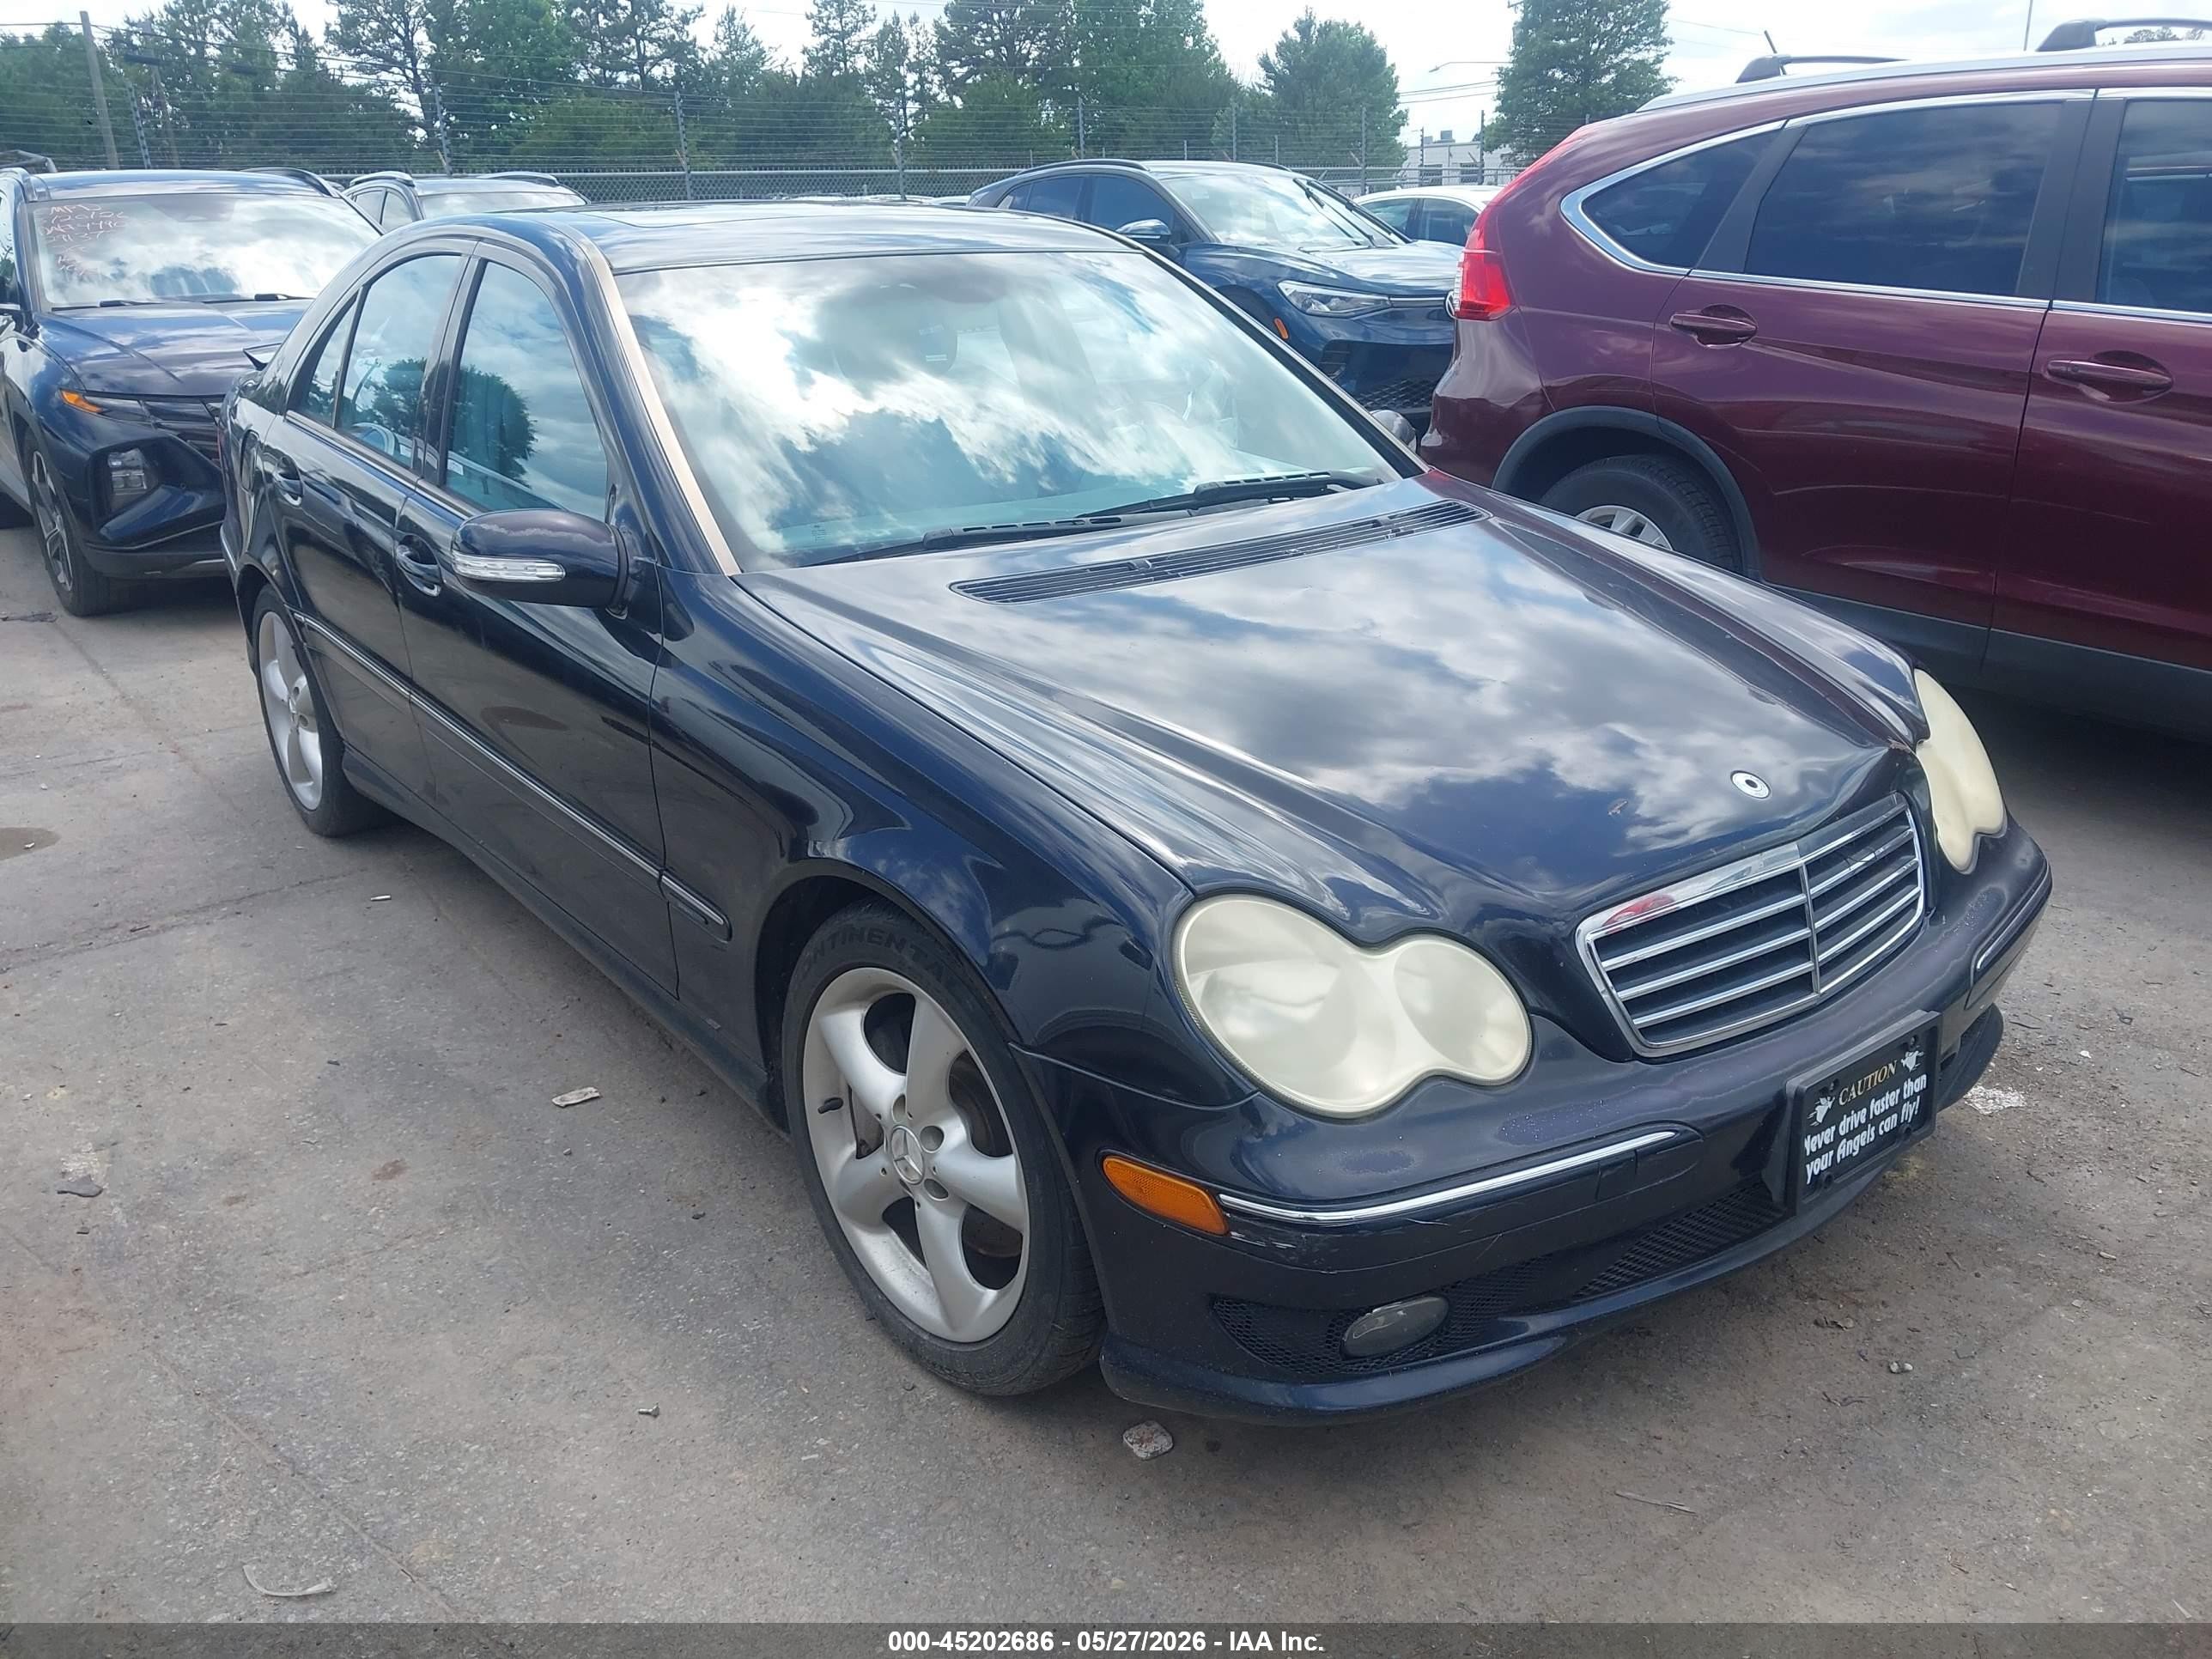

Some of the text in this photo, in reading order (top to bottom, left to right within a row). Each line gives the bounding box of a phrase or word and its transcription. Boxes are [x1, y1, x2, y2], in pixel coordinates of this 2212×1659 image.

[1838, 1060, 1898, 1106] CAUTION
[1838, 1108, 1868, 1136] drive
[1869, 1088, 1901, 1120] faster
[1903, 1073, 1927, 1100] than
[1805, 1095, 1920, 1185] your Angels can fly!
